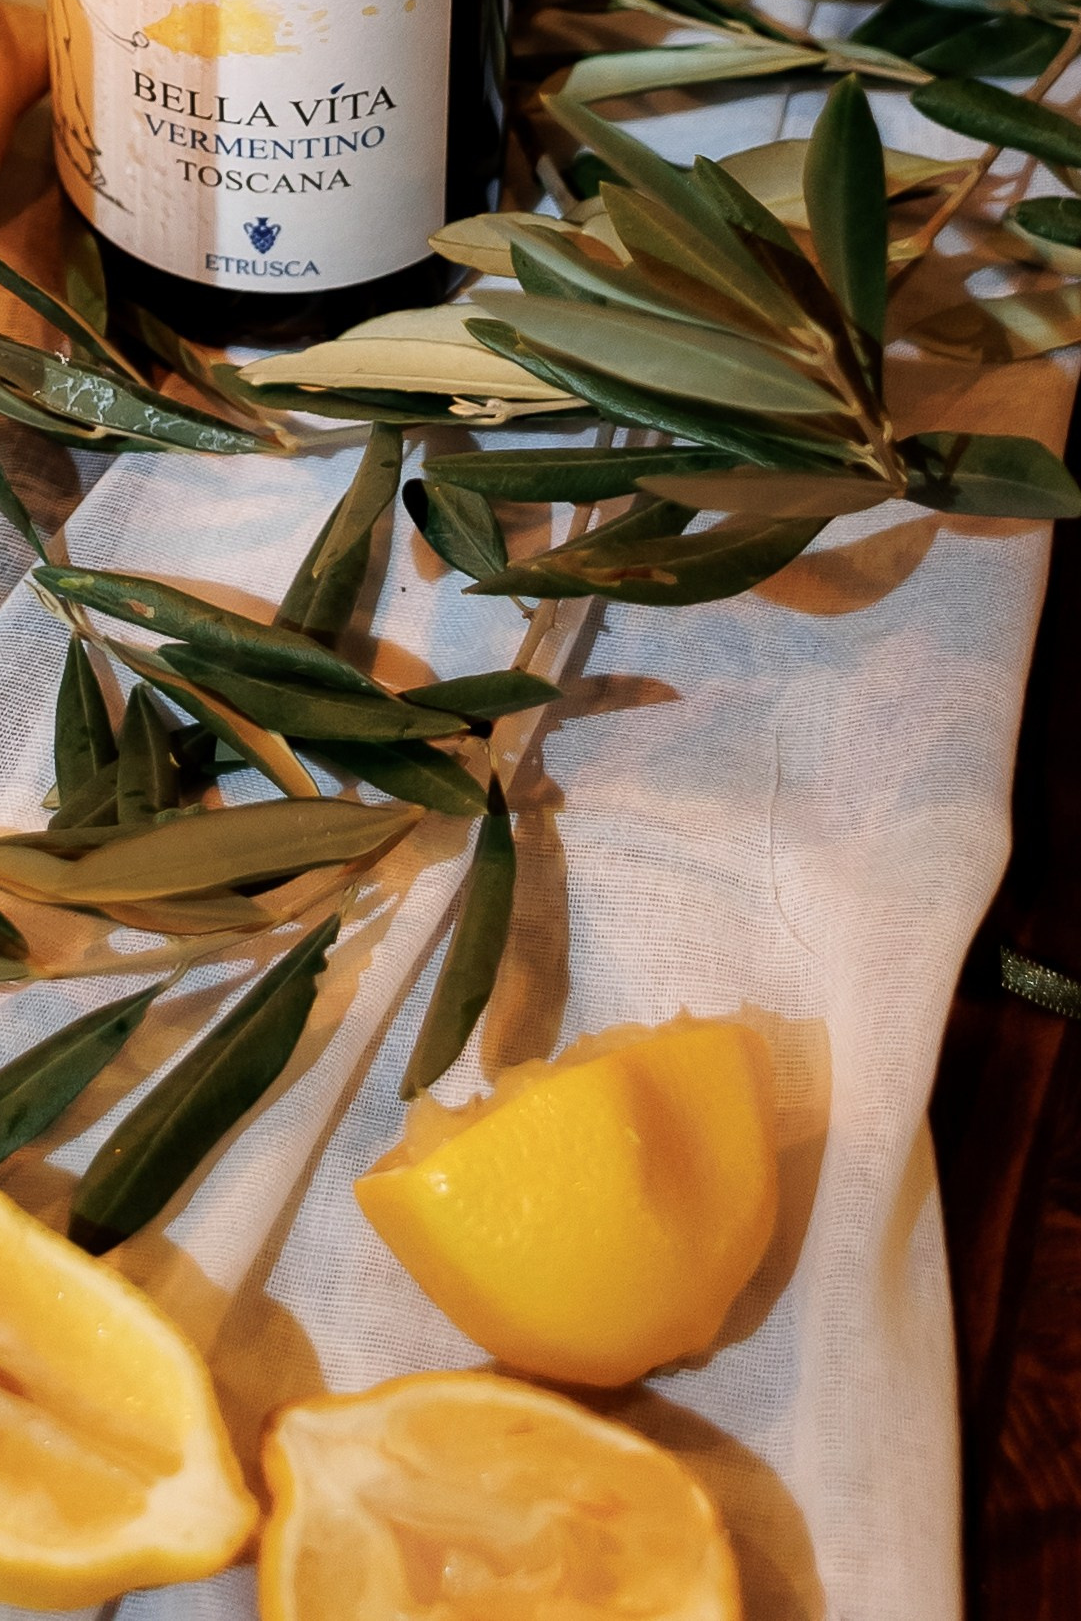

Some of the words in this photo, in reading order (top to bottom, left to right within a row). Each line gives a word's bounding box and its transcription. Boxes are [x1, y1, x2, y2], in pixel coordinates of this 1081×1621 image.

[132, 69, 279, 128] BELLA
[144, 113, 385, 160] VERMENTINO
[176, 159, 350, 193] TOSCANA
[205, 254, 320, 276] ETRUSCA
